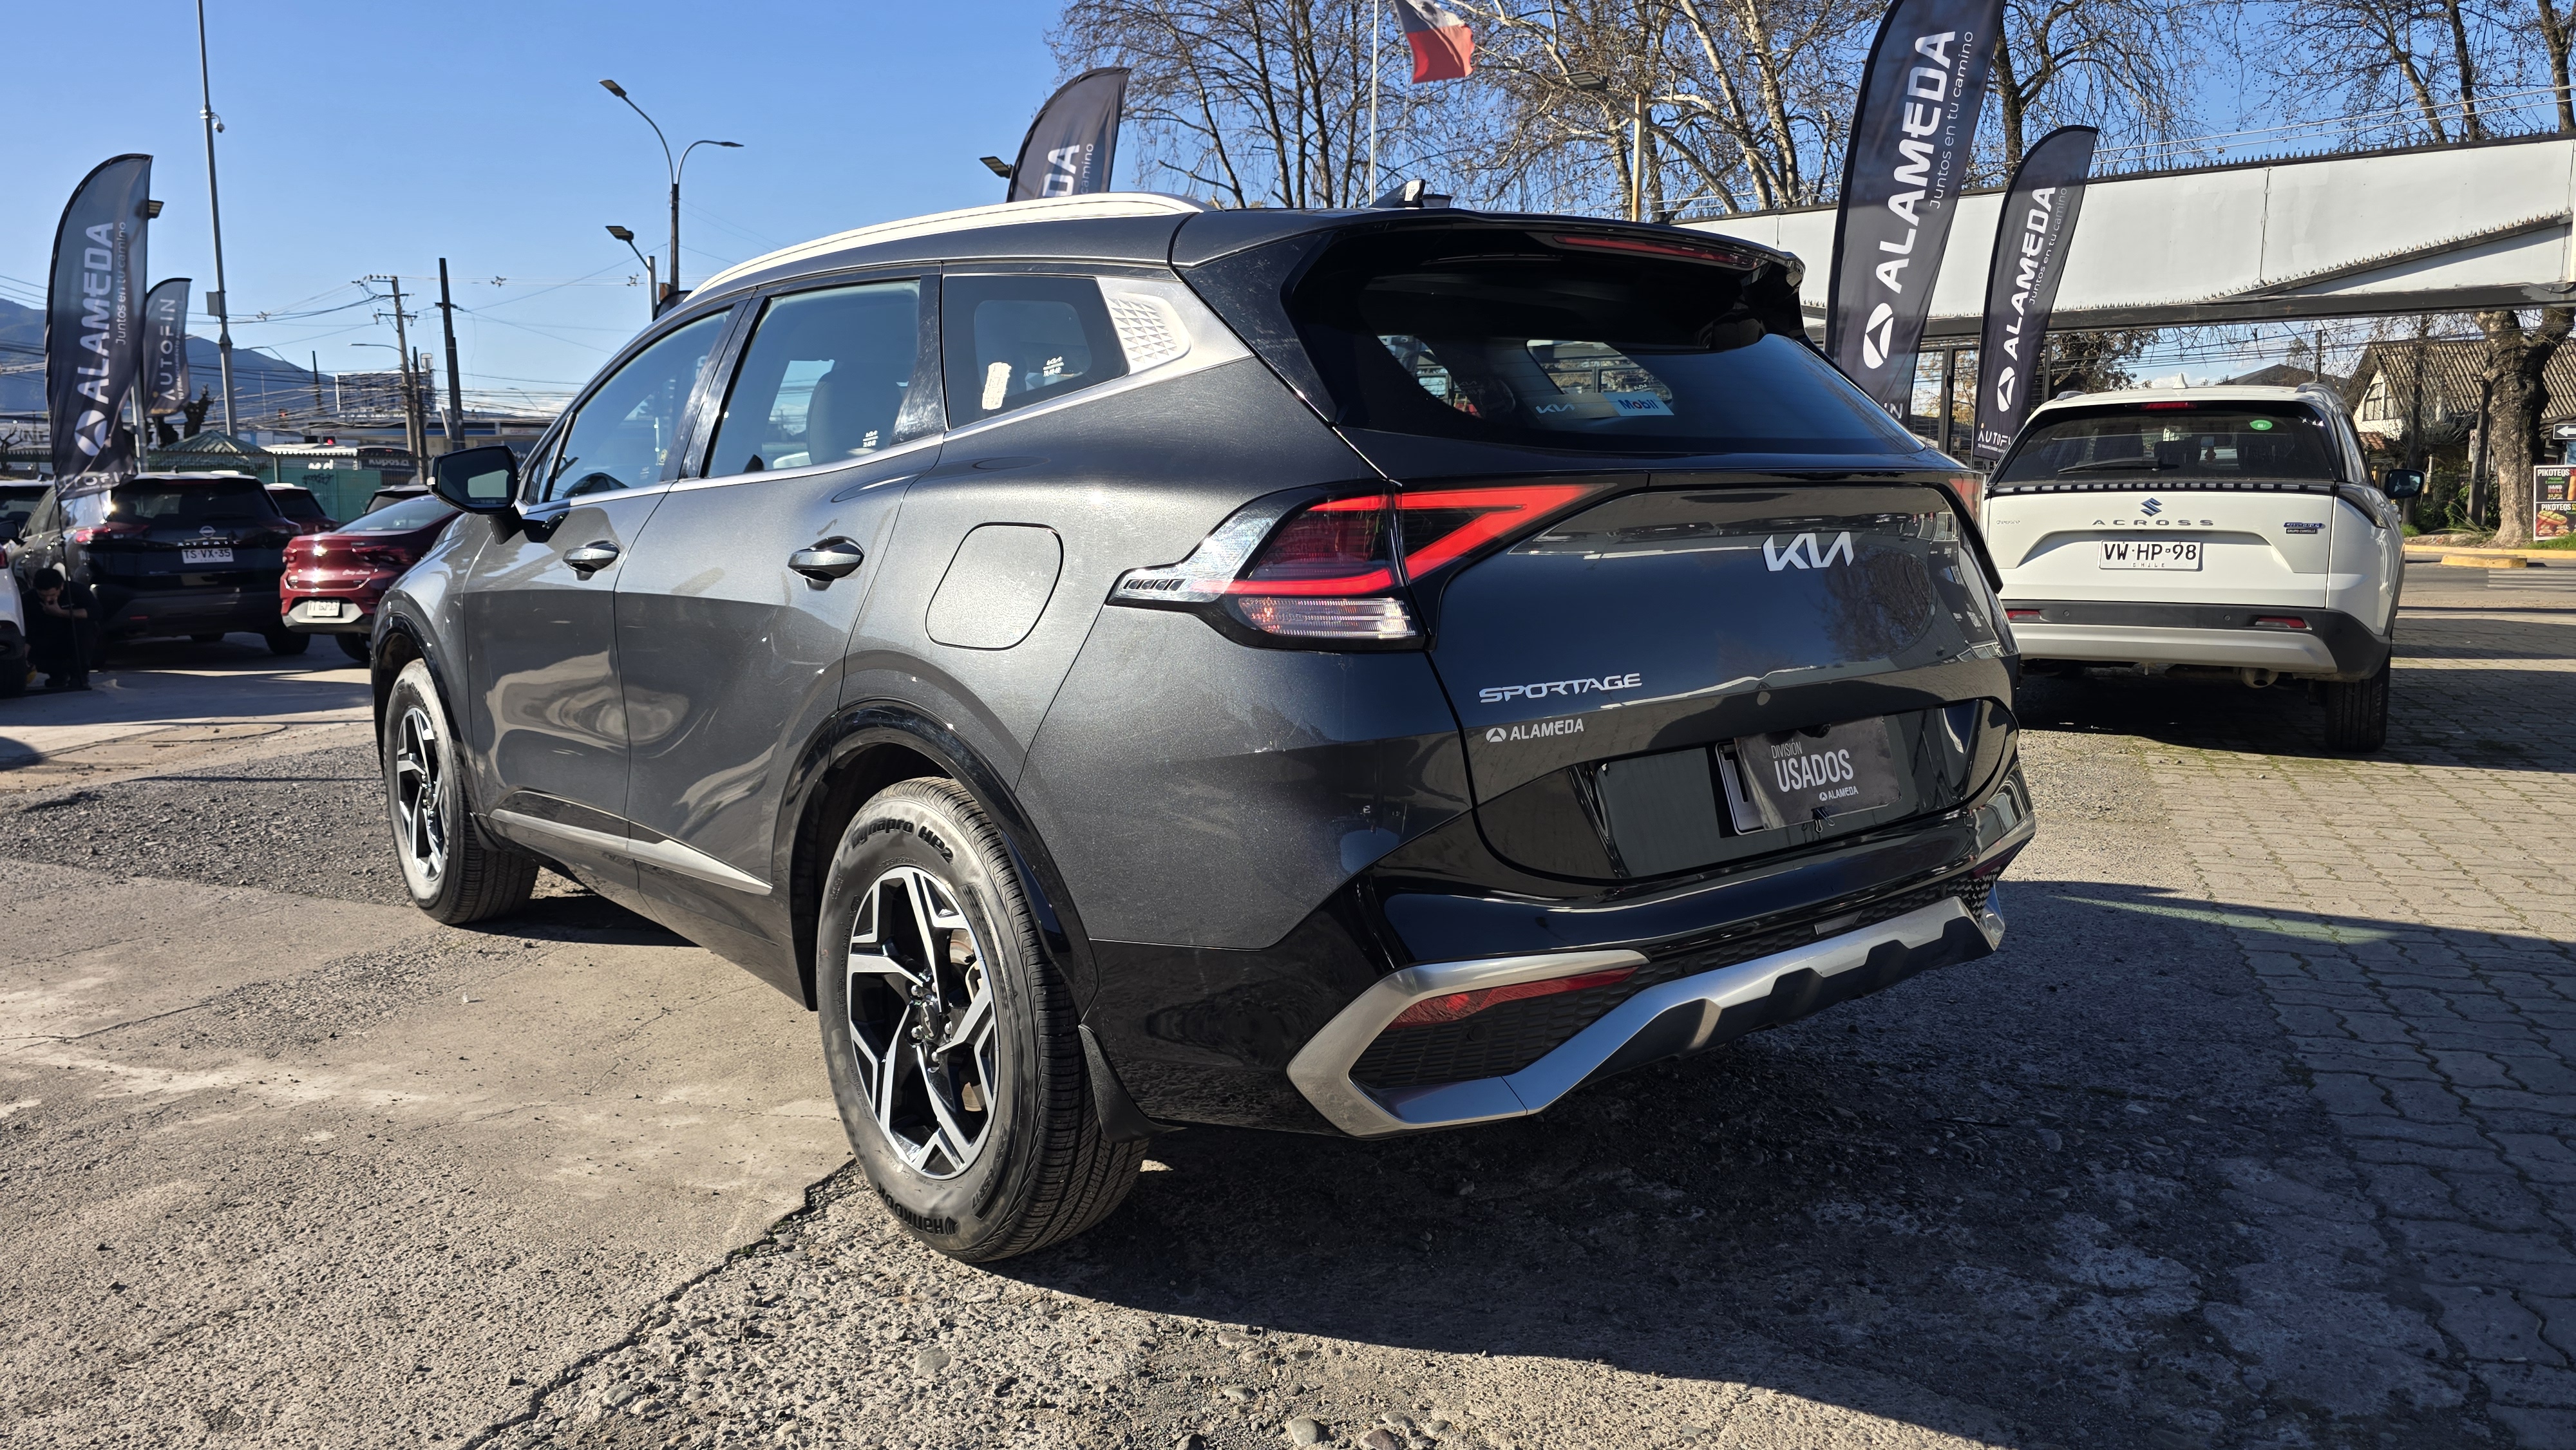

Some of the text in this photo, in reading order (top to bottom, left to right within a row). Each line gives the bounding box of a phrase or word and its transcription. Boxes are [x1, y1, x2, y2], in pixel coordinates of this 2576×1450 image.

[1929, 32, 1973, 209] Juntos en tu camino
[1081, 144, 1094, 194] camino
[1875, 32, 1955, 294] ALAMEDA
[2029, 188, 2067, 305] Juntos en tu camino
[116, 221, 126, 345] Juntos en tu camino
[2003, 187, 2056, 361] ALAMEDA
[77, 223, 113, 404] ALAMEDA
[160, 299, 176, 400] AUTOFIN
[1535, 404, 1575, 413] KIA
[1618, 399, 1660, 410] Mobil
[1763, 532, 1853, 571] KIA
[1479, 673, 1642, 702] SPORTAGE
[1510, 719, 1584, 740] ALAMEDA
[1771, 739, 1803, 758] DIVISIÓN
[1774, 749, 1854, 793] USADOS
[1828, 786, 1859, 800] ALAMEDA
[918, 825, 954, 865] HP2
